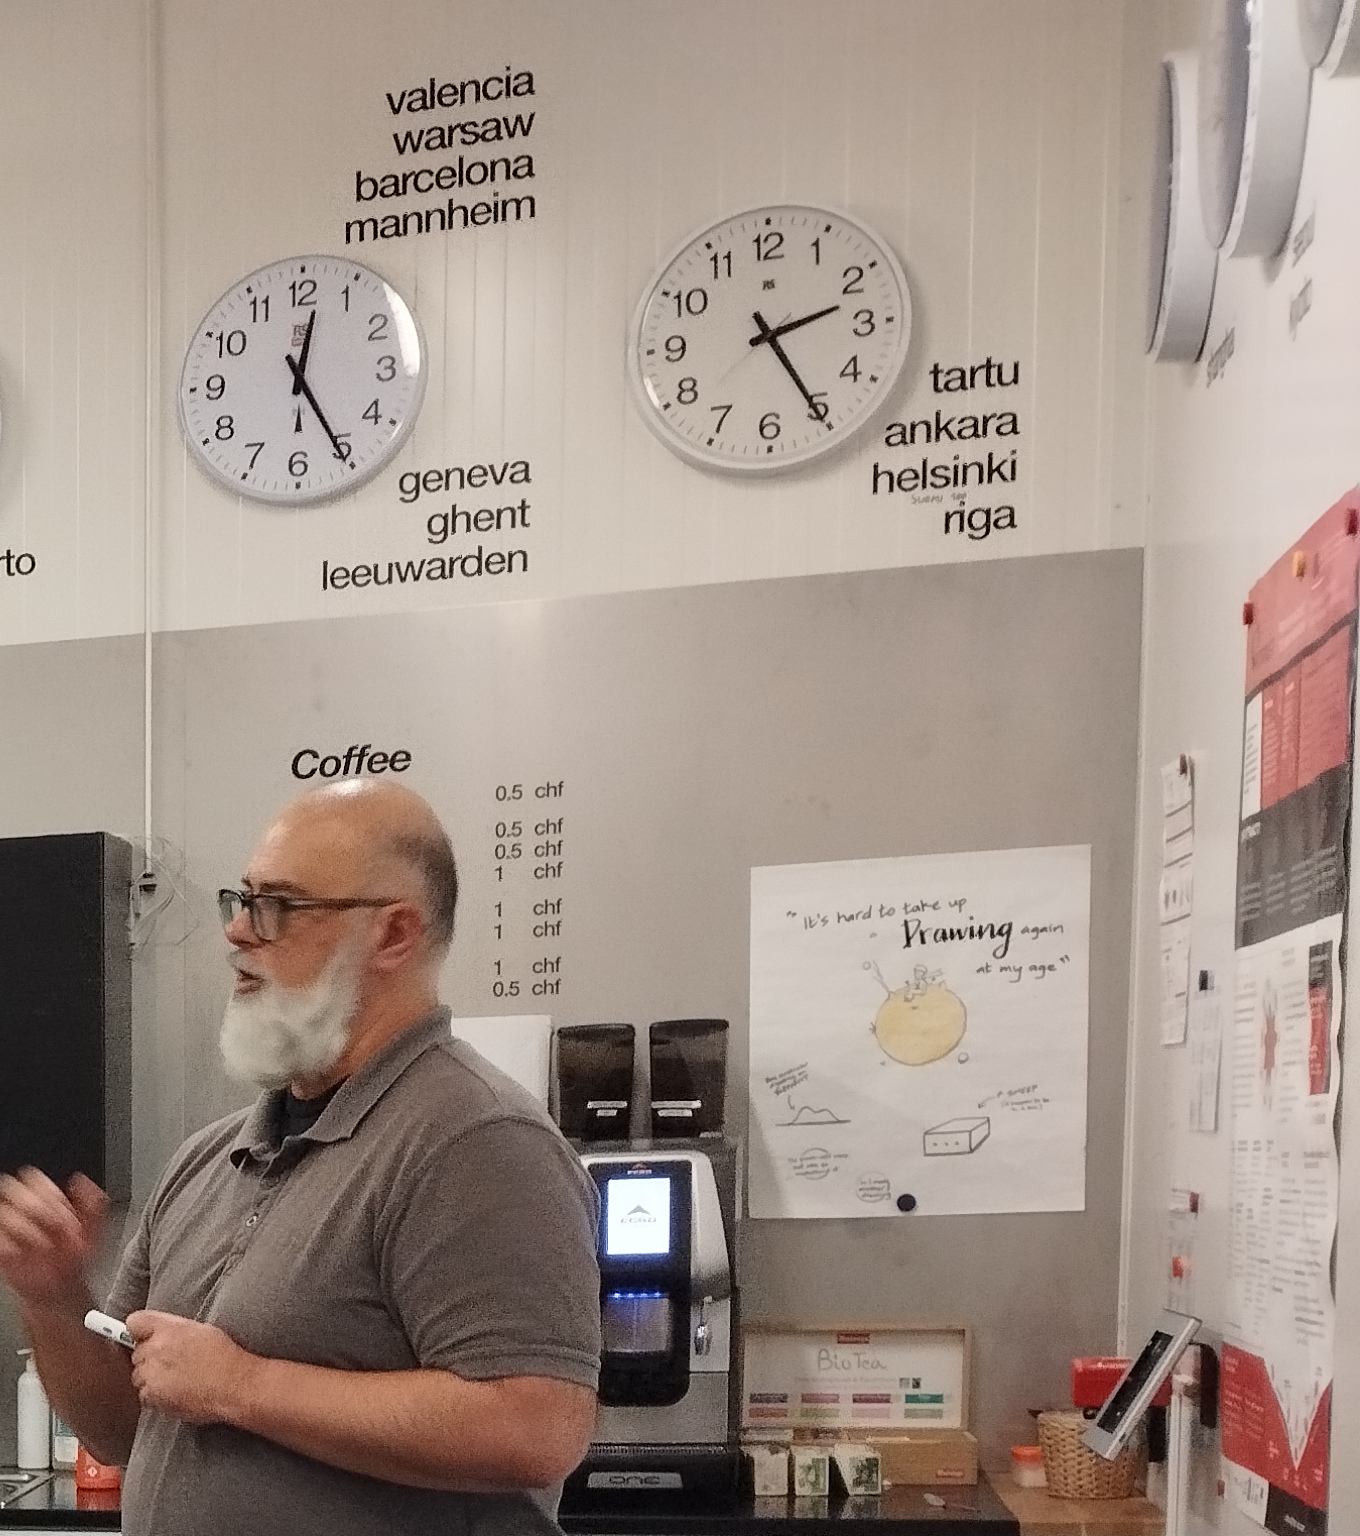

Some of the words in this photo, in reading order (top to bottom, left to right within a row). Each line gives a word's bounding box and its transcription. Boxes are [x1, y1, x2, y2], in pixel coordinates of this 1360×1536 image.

[385, 65, 535, 115] valencia
[392, 111, 536, 155] warsaw
[355, 152, 535, 202] barcelona
[345, 191, 536, 244] mannheim
[753, 232, 784, 261] 12
[811, 237, 819, 265] 1
[710, 251, 731, 279] 11
[288, 279, 317, 307] 12
[842, 266, 864, 295] 2
[250, 295, 269, 323] 11
[341, 285, 350, 312] 1
[674, 288, 708, 317] 10
[368, 314, 388, 341] 2
[853, 309, 875, 337] 3
[216, 330, 246, 358] 10
[665, 335, 686, 362] 9
[376, 355, 396, 382] 3
[839, 354, 862, 383] 4
[929, 356, 1020, 394] tartu
[206, 374, 225, 400] 9
[677, 377, 698, 405] 8
[362, 398, 382, 425] 4
[711, 404, 732, 433] 7
[808, 392, 829, 420] 5
[215, 415, 234, 440] 8
[759, 413, 780, 440] 6
[884, 409, 1021, 447] ankara
[245, 442, 265, 470] 7
[332, 433, 352, 459] 5
[288, 451, 308, 477] 6
[872, 449, 1017, 496] helsinki
[398, 459, 531, 503] geneva
[426, 498, 531, 544] ghent
[943, 500, 1017, 540] riga
[321, 545, 528, 591] leeuwarden
[291, 744, 412, 780] Coffee
[495, 784, 523, 802] 0.5
[535, 781, 564, 800] chf
[495, 821, 523, 839] 0.5
[534, 818, 563, 836] chf
[494, 843, 522, 860] 0.5
[534, 840, 563, 858] chf
[494, 865, 504, 882] 1
[534, 862, 563, 880] chf
[494, 902, 503, 918] 1
[533, 899, 562, 917] chf
[837, 905, 872, 924] hard
[879, 904, 896, 918] to
[903, 899, 941, 915] take
[949, 898, 967, 913] up
[494, 924, 503, 940] 1
[533, 921, 562, 938] chf
[902, 915, 1013, 959] Drawing
[1020, 924, 1064, 940] again
[494, 959, 502, 976] 1
[532, 957, 561, 975] chf
[976, 962, 992, 974] at
[1000, 964, 1023, 983] my
[493, 981, 520, 998] 0.5
[532, 978, 561, 997] chf
